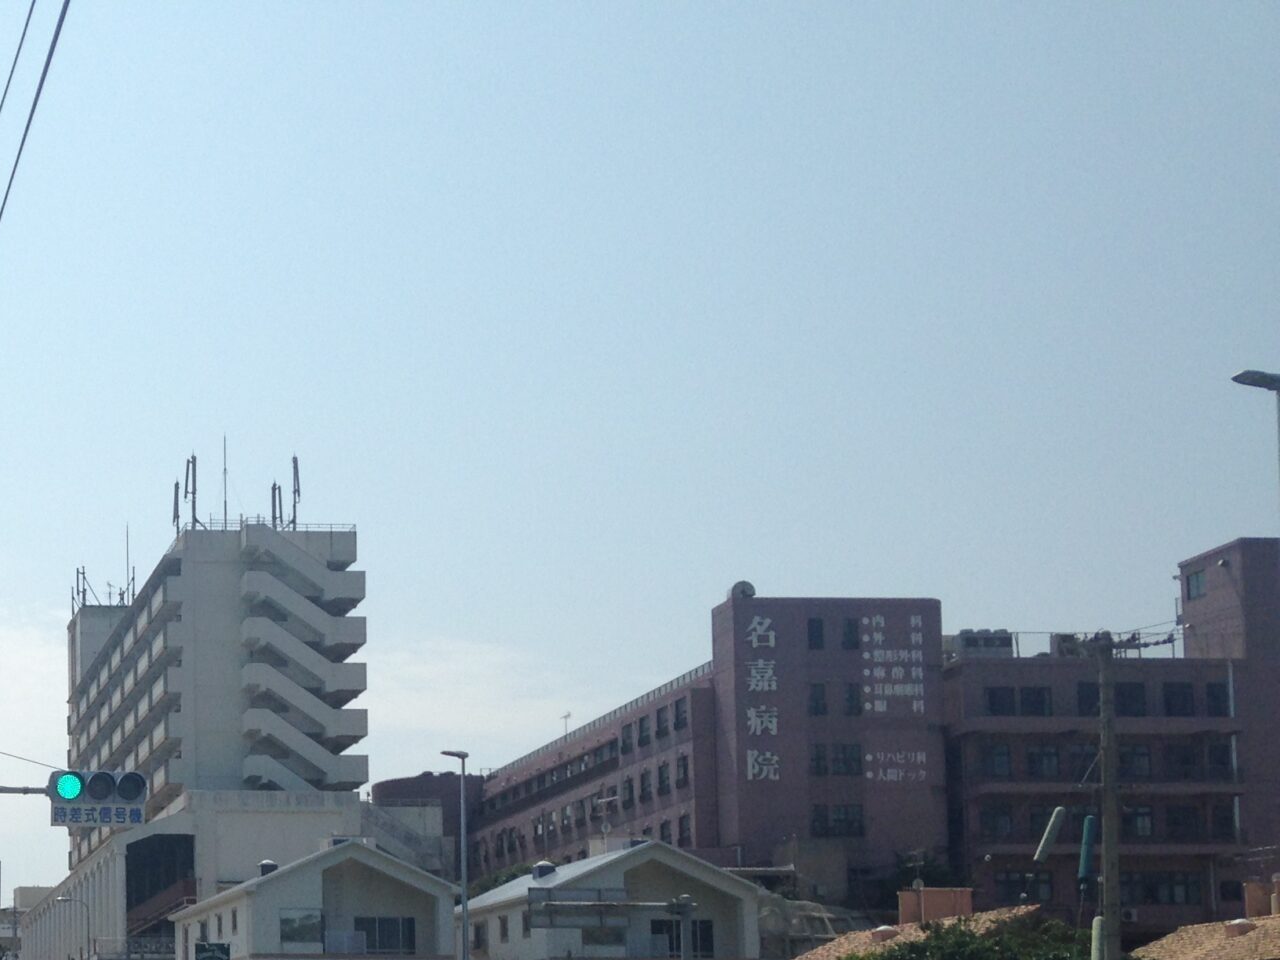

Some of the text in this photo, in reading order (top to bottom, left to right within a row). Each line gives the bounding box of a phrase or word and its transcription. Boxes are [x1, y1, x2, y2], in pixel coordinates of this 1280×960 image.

[744, 615, 780, 781] 名嘉病院
[53, 806, 142, 824] 時差式信号機
